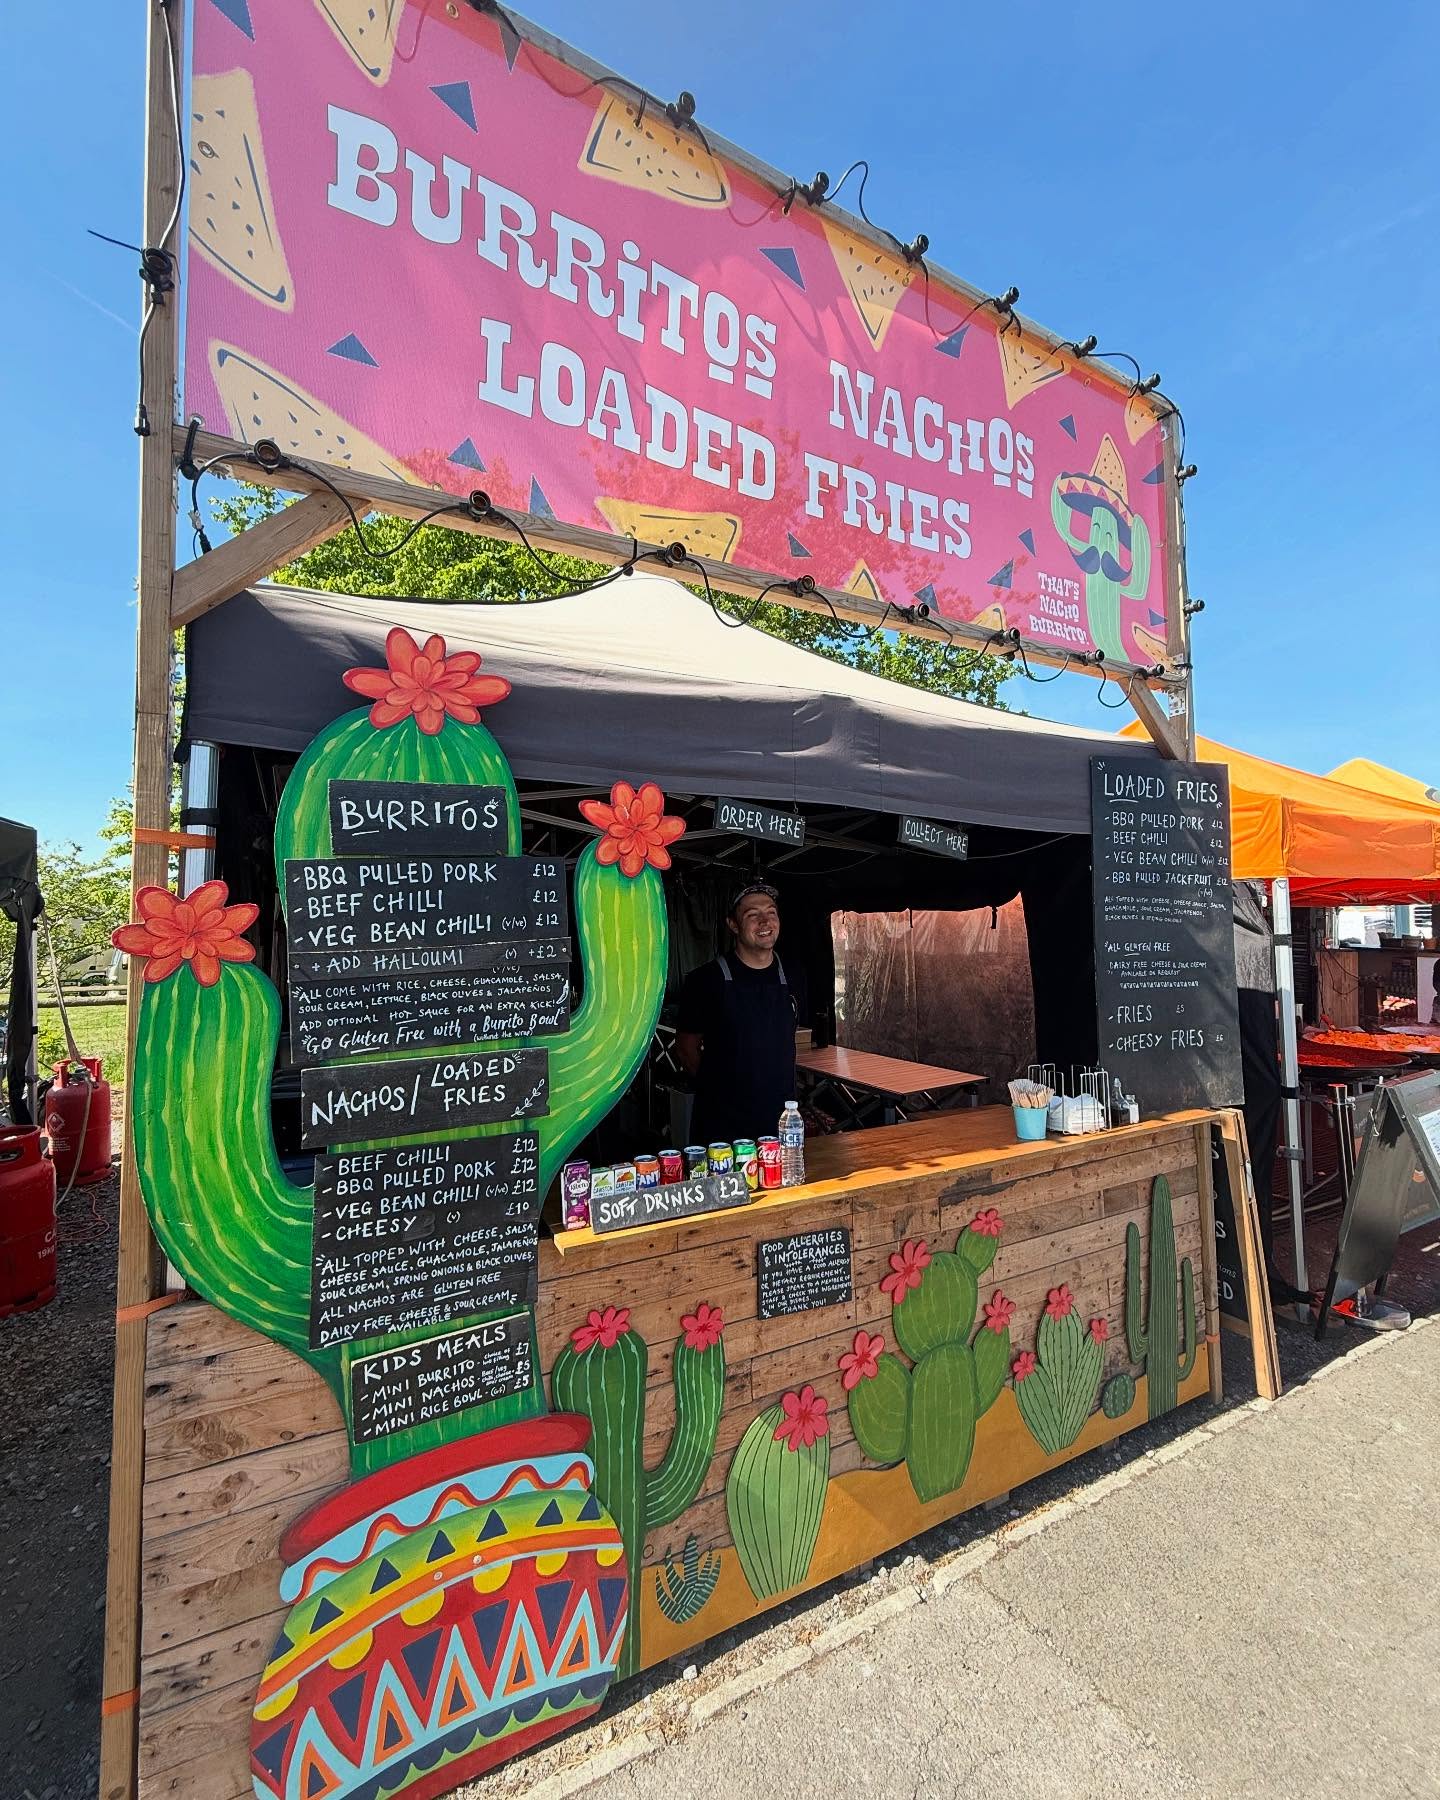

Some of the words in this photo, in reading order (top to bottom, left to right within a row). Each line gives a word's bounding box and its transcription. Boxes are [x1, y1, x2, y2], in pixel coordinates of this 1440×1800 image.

[478, 317, 776, 502] LOADED
[804, 451, 973, 560] FRIES
[829, 360, 1035, 499] NACHOS
[1038, 572, 1080, 600] THAT'S
[1040, 594, 1079, 622] NACHO
[1104, 773, 1165, 799] LOADED
[1176, 780, 1218, 803] FRIES
[340, 799, 499, 832] BURRITOS
[720, 804, 764, 833] ORDER
[768, 815, 801, 839] HERE
[1112, 811, 1134, 826] BBQ
[1140, 812, 1176, 828] PULLED
[1179, 815, 1205, 831] PORK
[1211, 819, 1223, 830] £12
[904, 819, 943, 844] COLLECT
[946, 834, 968, 853] HERE
[1113, 831, 1137, 845] BEEF
[1140, 832, 1168, 846] CHILLI
[1210, 839, 1223, 848] £12
[1113, 851, 1133, 864] VEG
[1139, 851, 1167, 865] BEAN
[1171, 852, 1198, 866] CHILLI
[1217, 857, 1229, 866] £12
[304, 865, 347, 890] BBQ
[359, 862, 433, 887] PULLED
[443, 862, 497, 883] PORK
[532, 864, 556, 877] £12
[1112, 871, 1131, 884] BBQ
[1135, 872, 1161, 884] PULLED
[1165, 872, 1212, 886] JACKFRUIT
[1216, 877, 1229, 886] £12
[308, 893, 363, 919] BEEF
[373, 890, 443, 914] CHILLI
[533, 890, 558, 903] £12
[308, 925, 356, 946] VEG
[371, 919, 425, 943] BEAN
[436, 913, 491, 936] CHILLI
[535, 913, 559, 927] £12
[326, 955, 360, 973] ADD
[372, 949, 463, 972] HALLOUMI
[1107, 942, 1120, 952] ALL
[1124, 942, 1151, 952] GLUTEN
[1153, 942, 1171, 952] FREE
[1109, 961, 1130, 969] DAIRY
[1151, 960, 1171, 968] CHEESE
[299, 989, 321, 1003] ALL
[326, 985, 356, 998] COME
[362, 982, 390, 992] WITH
[533, 972, 565, 982] SALSA,
[299, 1003, 324, 1014] SOUR
[326, 1000, 369, 1011] CREAM,
[420, 991, 448, 1002] BLACK
[451, 989, 483, 999] OLIVES
[299, 1020, 322, 1032] ADD
[327, 1014, 379, 1027] OPTIONAL
[389, 1011, 412, 1021] HOT
[418, 1008, 451, 1019] SAUCE
[456, 1005, 475, 1014] FOR
[479, 1002, 493, 1012] AN
[497, 1001, 526, 1011] EXTRA
[530, 1000, 556, 1010] KICK!
[339, 1030, 389, 1049] Gluten
[396, 1026, 426, 1044] Free
[433, 1018, 461, 1039] with
[469, 1022, 477, 1033] a
[482, 1013, 524, 1033] Burrito
[528, 1008, 561, 1031] Bowl
[1117, 1004, 1152, 1024] FRIES
[1116, 1033, 1162, 1052] CHEESY
[1171, 1029, 1204, 1050] FRIES
[430, 1057, 516, 1087] LOADED
[443, 1084, 506, 1112] FRIES
[783, 1133, 799, 1143] ICE
[338, 1153, 388, 1176] BEEF
[396, 1145, 450, 1167] CHILLI
[512, 1138, 538, 1154] £12
[709, 1158, 734, 1172] FANT
[336, 1177, 374, 1196] BBQ
[383, 1166, 445, 1190] PULLED
[454, 1160, 496, 1183] PORK
[510, 1158, 537, 1174] £12
[637, 1170, 659, 1186] FANT
[335, 1201, 373, 1220] VEG
[380, 1192, 426, 1215] BEAN
[433, 1184, 480, 1205] CHILLI
[511, 1179, 537, 1195] £12
[599, 1196, 639, 1224] SOFT
[643, 1184, 705, 1214] DRINKS
[720, 1177, 745, 1199] £2
[336, 1216, 417, 1241] CHEESY
[505, 1201, 530, 1216] £10
[321, 1256, 350, 1275] ALL
[353, 1247, 405, 1267] TOPPED
[409, 1237, 446, 1256] WITH
[454, 1226, 503, 1247] CHEESE,
[505, 1222, 537, 1236] SALSA,
[762, 1242, 783, 1256] FOOD
[788, 1231, 842, 1250] ALLERGIES
[774, 1243, 845, 1264] INTOLERANCES
[319, 1288, 347, 1302] SOUR
[349, 1280, 389, 1295] CREAM,
[393, 1272, 429, 1286] SPRING
[431, 1264, 465, 1278] ONIONS
[475, 1257, 501, 1270] BLACK
[320, 1270, 367, 1289] CHEESE
[417, 1245, 490, 1267] GUACAMOLE,
[786, 1265, 803, 1275] HAVE
[813, 1263, 827, 1271] FOOD
[827, 1258, 850, 1267] ALLERGY
[319, 1306, 345, 1325] ALL
[348, 1295, 396, 1314] NACHOS
[401, 1287, 424, 1302] ARE
[434, 1278, 474, 1294] GLUTEN
[476, 1271, 502, 1286] FREE
[762, 1287, 785, 1299] PLEASE
[780, 1303, 809, 1315] THANK
[811, 1298, 827, 1308] YOU!
[320, 1322, 361, 1344] DAIRY
[363, 1314, 393, 1332] FREE
[399, 1305, 441, 1322] CHEESE
[453, 1299, 476, 1311] SOUR
[476, 1290, 510, 1306] CREAM
[387, 1312, 452, 1334] AVAILABLE
[364, 1349, 422, 1385] KIDS
[436, 1324, 506, 1360] MEALS
[372, 1379, 409, 1404] MINI
[417, 1359, 475, 1387] BURRITO
[515, 1342, 529, 1356] £7
[372, 1396, 412, 1420] MINI
[421, 1375, 475, 1403] NACHOS
[514, 1359, 531, 1375] £5
[375, 1411, 415, 1436] MINI
[420, 1400, 449, 1419] RICE
[453, 1388, 483, 1409] BOWL
[513, 1374, 530, 1390] £5
